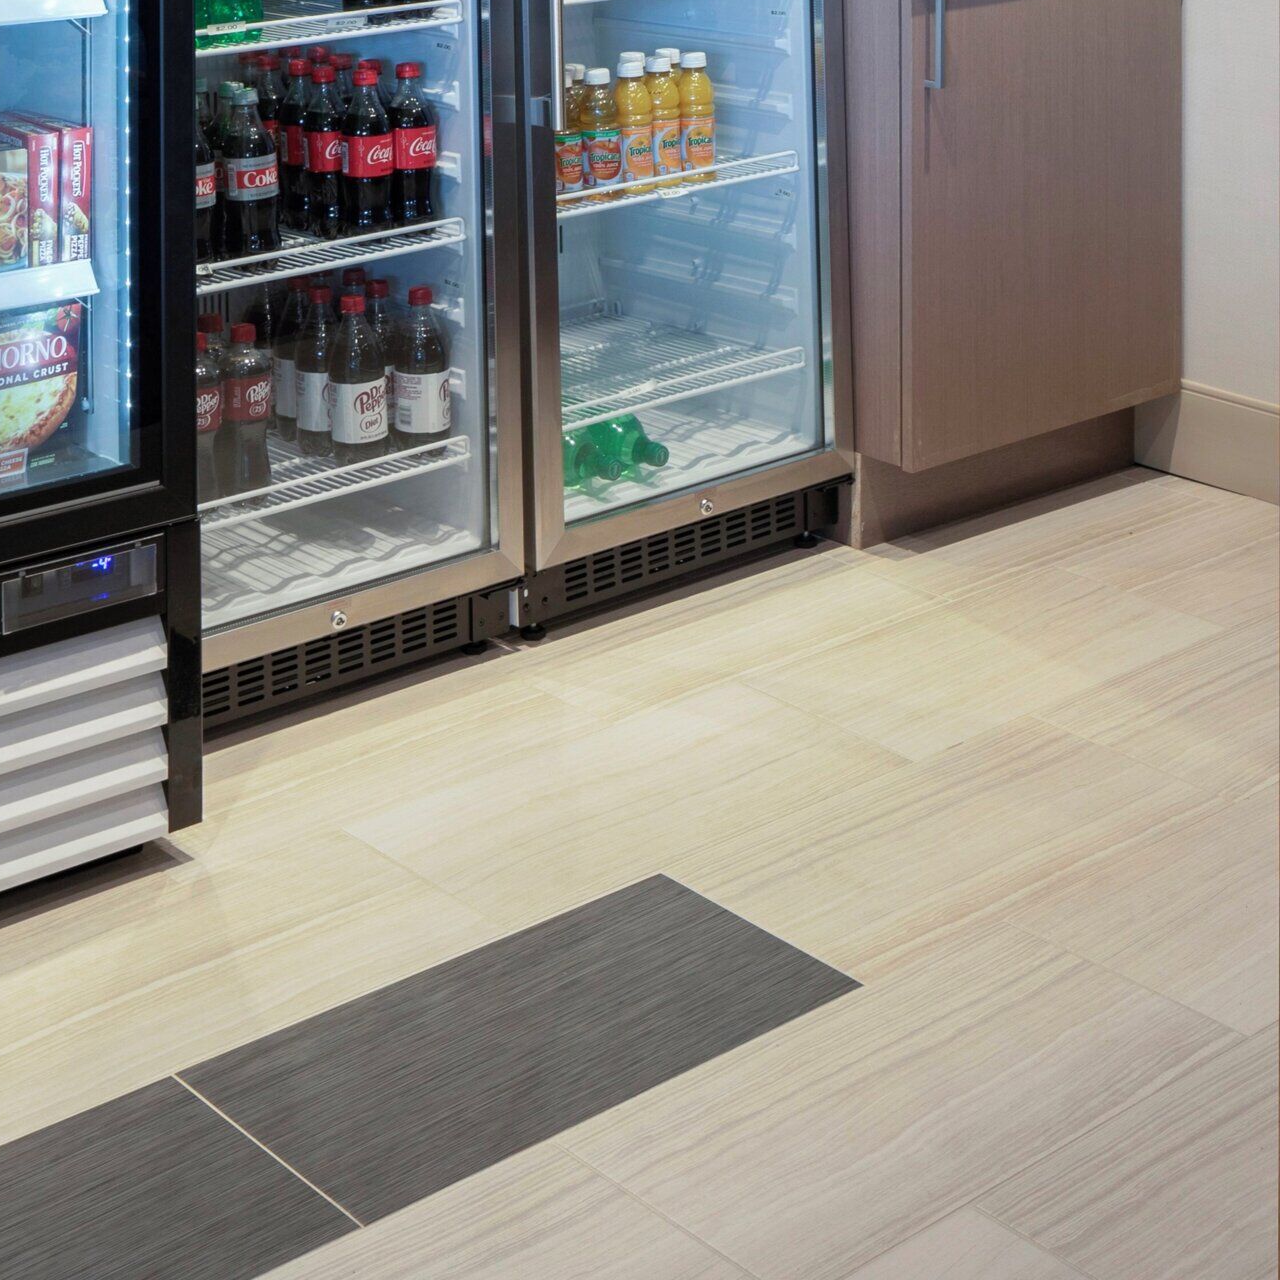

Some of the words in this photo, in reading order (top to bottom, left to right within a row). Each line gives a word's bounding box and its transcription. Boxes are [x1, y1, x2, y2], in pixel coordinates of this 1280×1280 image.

[73, 143, 83, 161] HOT
[72, 162, 83, 197] POCKETS
[243, 170, 277, 188] Coke
[33, 362, 69, 378] CRUST
